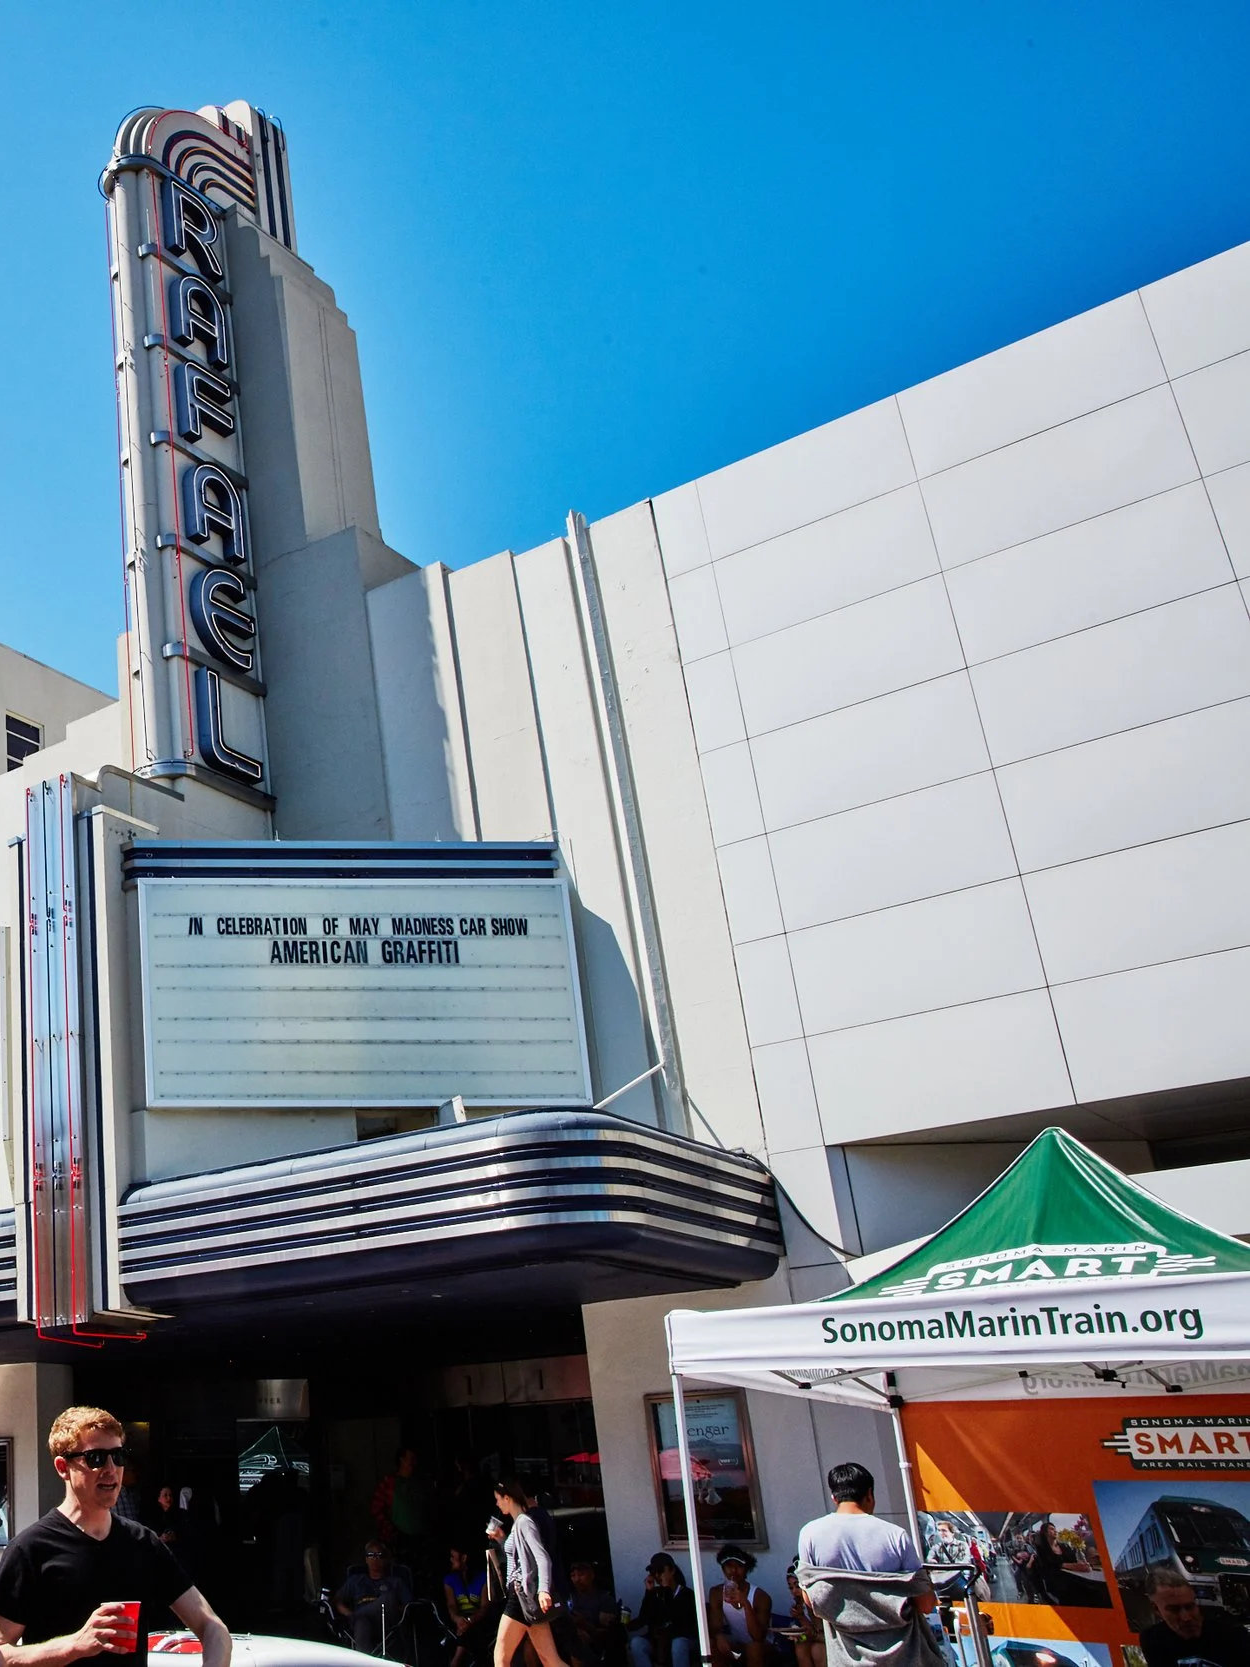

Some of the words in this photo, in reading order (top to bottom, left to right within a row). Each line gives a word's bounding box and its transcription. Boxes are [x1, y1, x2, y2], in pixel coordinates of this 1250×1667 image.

[162, 176, 262, 785] RAFAEL
[188, 917, 202, 935] IN
[216, 917, 307, 935] CELEBRATION
[322, 917, 339, 935] OF
[349, 917, 380, 935] MAY
[391, 917, 455, 935] MADNESS
[459, 917, 486, 935] CAR
[491, 917, 528, 936] SHOW
[270, 940, 368, 964] AMERICAN
[381, 939, 460, 964] GRAFFITI
[945, 1244, 1148, 1269] SONOMA-MARIN
[933, 1256, 1147, 1291] SMART
[821, 1303, 1204, 1345] SonomaMarinTrain.org
